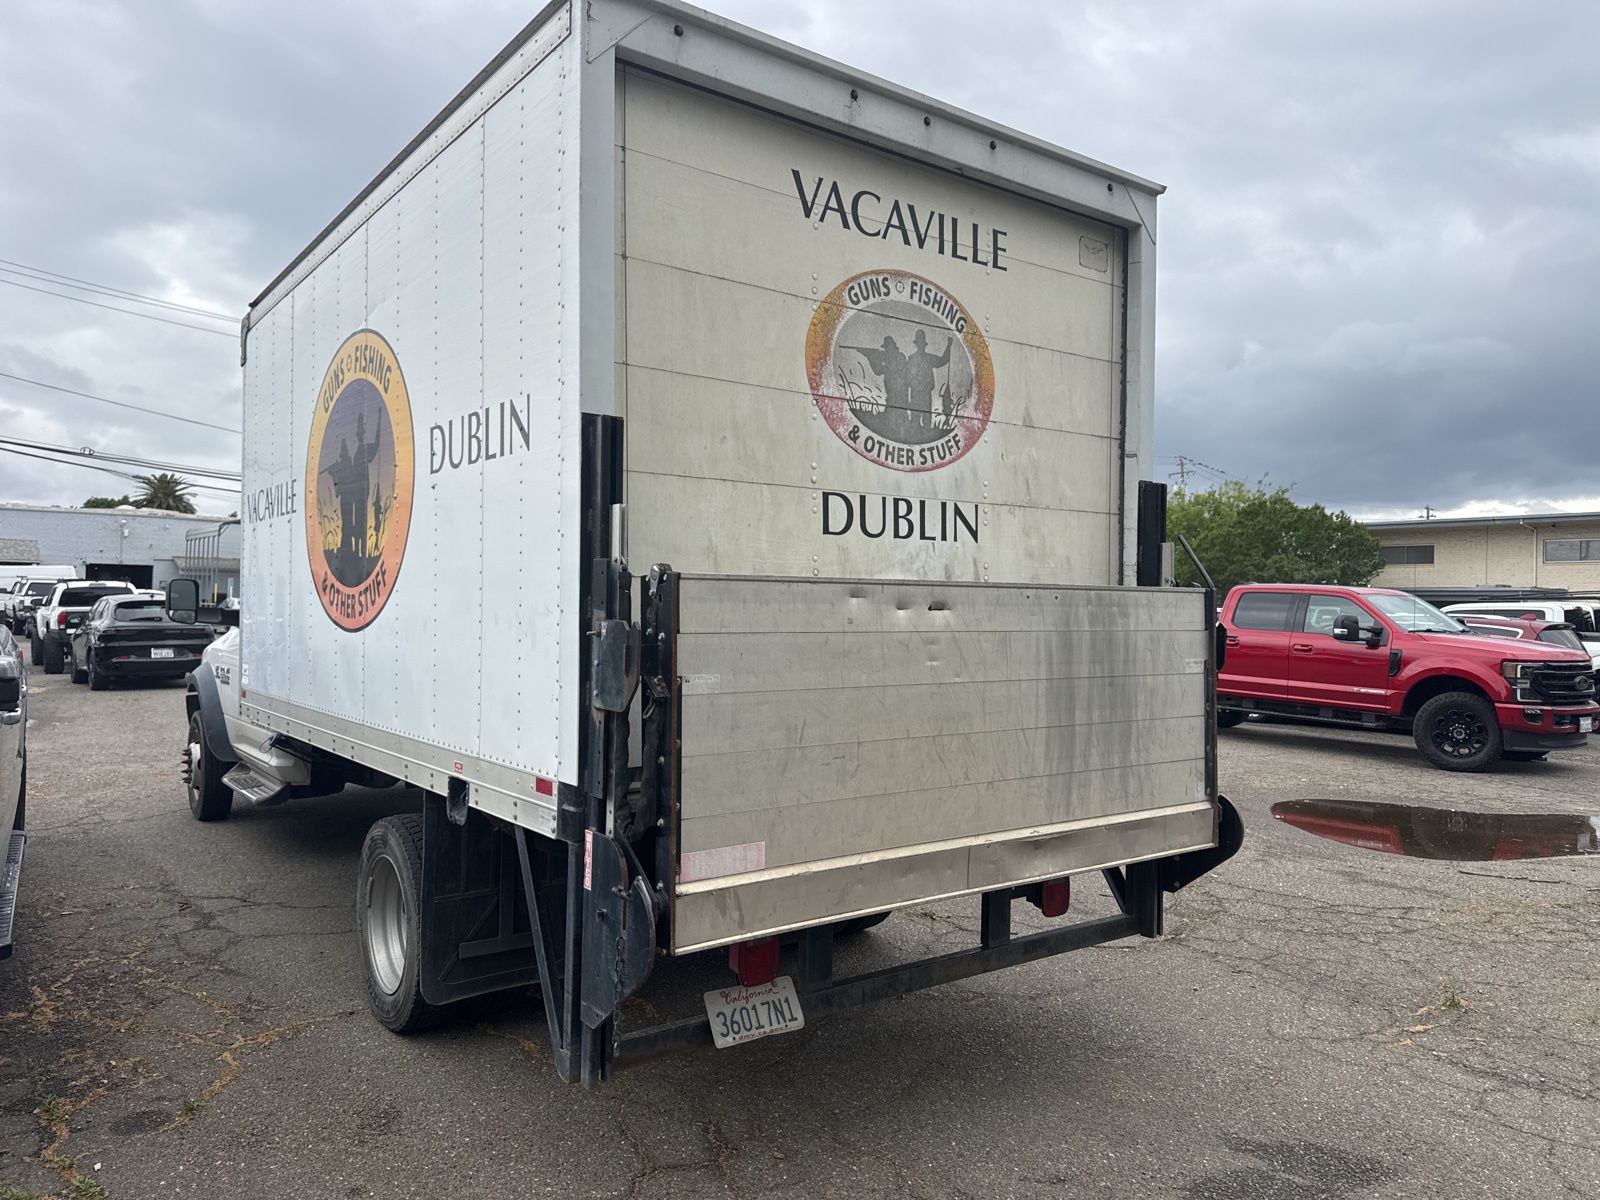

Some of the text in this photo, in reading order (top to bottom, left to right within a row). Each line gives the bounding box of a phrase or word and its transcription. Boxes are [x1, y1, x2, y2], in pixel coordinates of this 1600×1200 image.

[791, 168, 1008, 272] VACAVILLE
[847, 276, 968, 334] GUNS FISHING
[323, 343, 392, 414] GUNS FISHING
[429, 393, 531, 475] DUBLIN
[847, 424, 961, 466] & OTHER STUFF
[247, 478, 298, 525] VACAVILLE
[821, 491, 979, 544] DUBLIN
[321, 559, 386, 619] & OTHER STUFF
[716, 996, 798, 1037] 36017N1
[725, 987, 779, 1004] California
